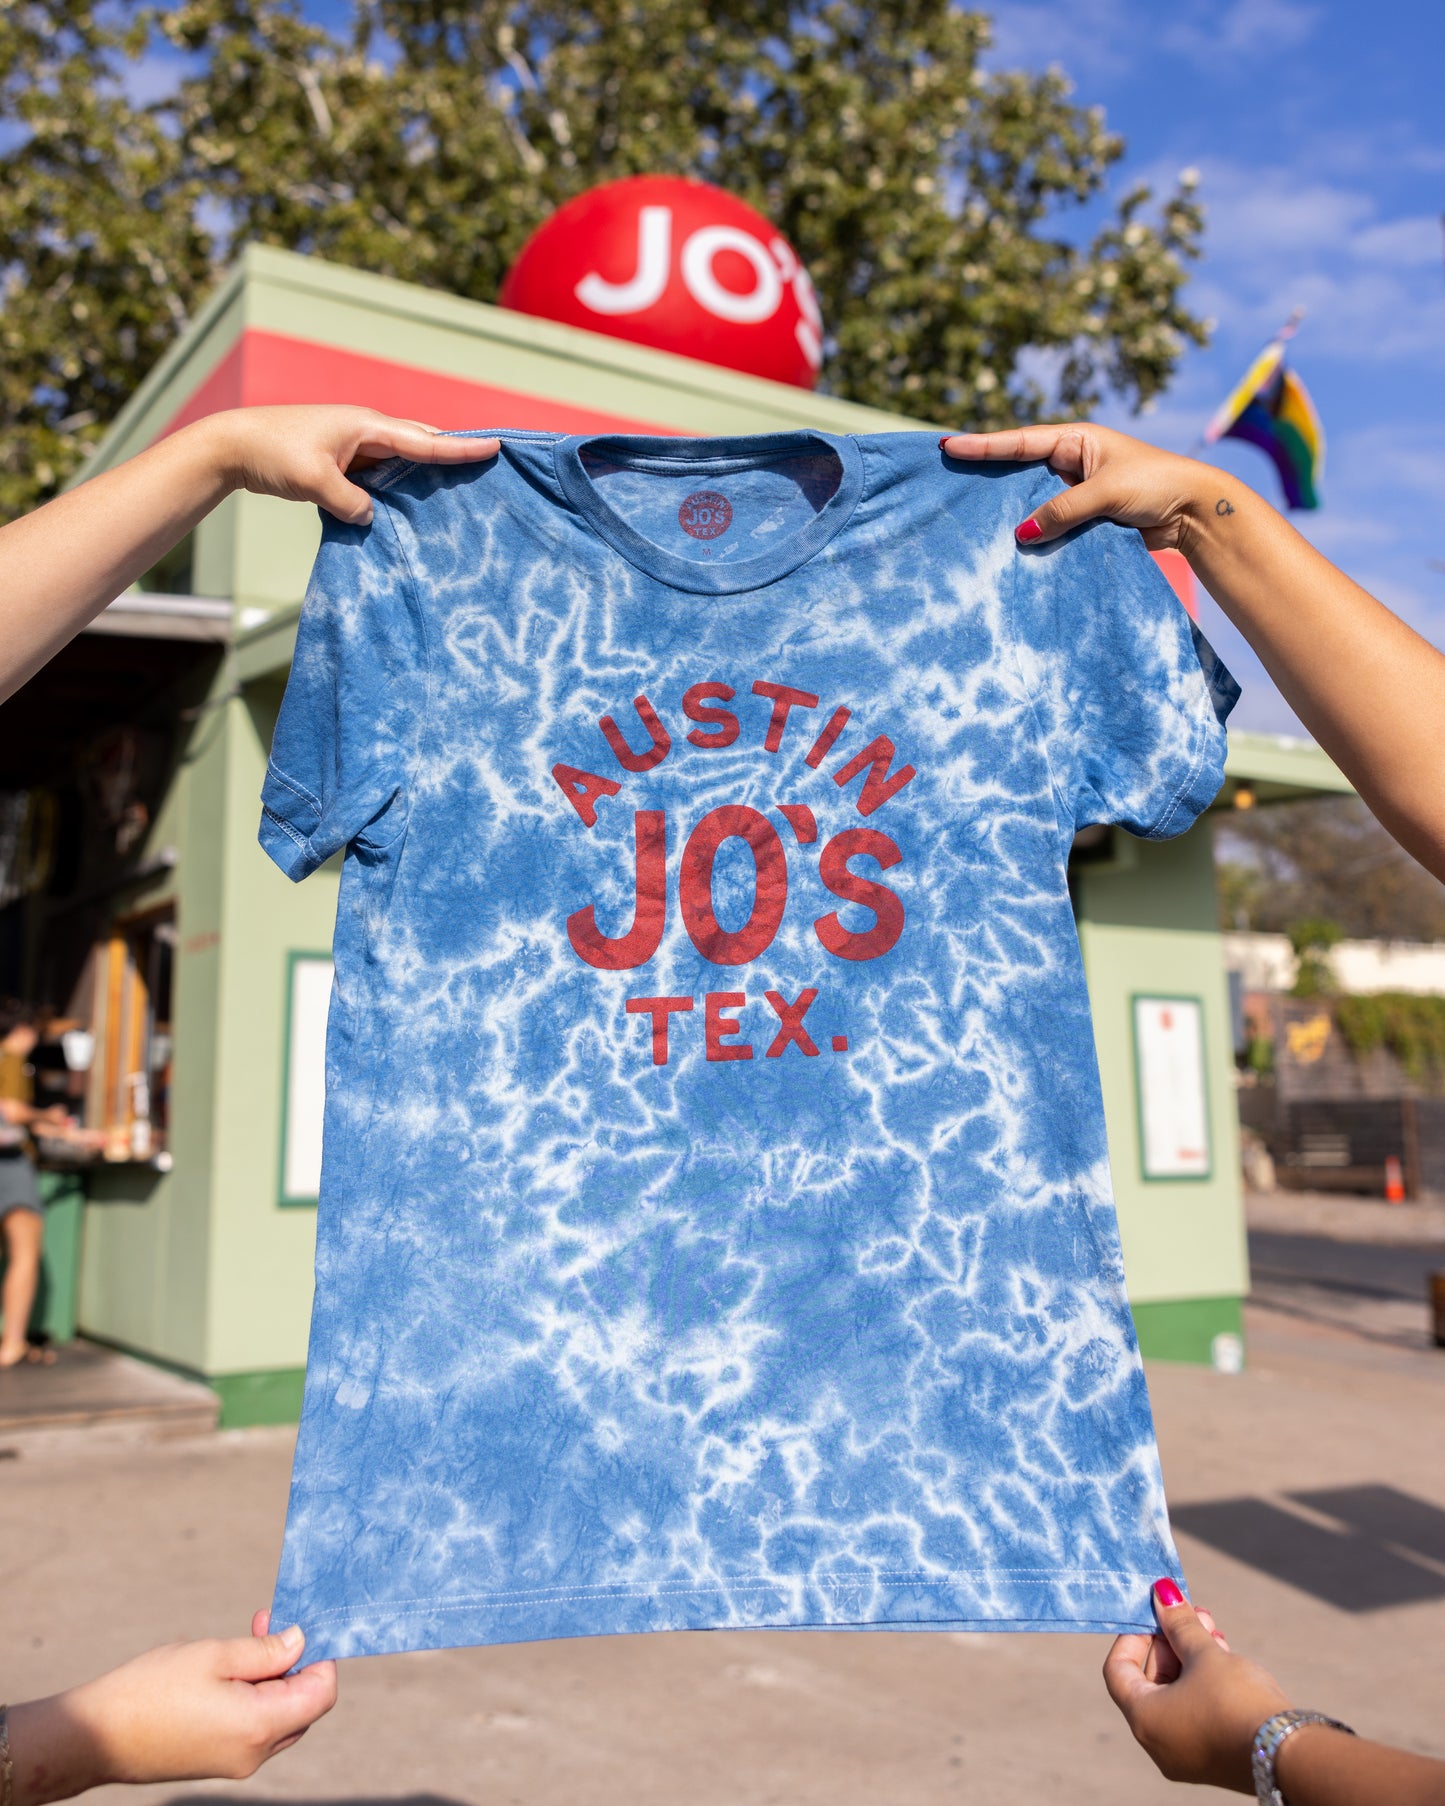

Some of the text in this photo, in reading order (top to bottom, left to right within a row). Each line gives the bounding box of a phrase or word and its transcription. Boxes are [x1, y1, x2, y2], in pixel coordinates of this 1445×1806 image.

[686, 508, 725, 525] JO'S
[552, 680, 916, 828] AUSTIN
[567, 804, 905, 970] JO'S
[626, 988, 848, 1066] TEX.
